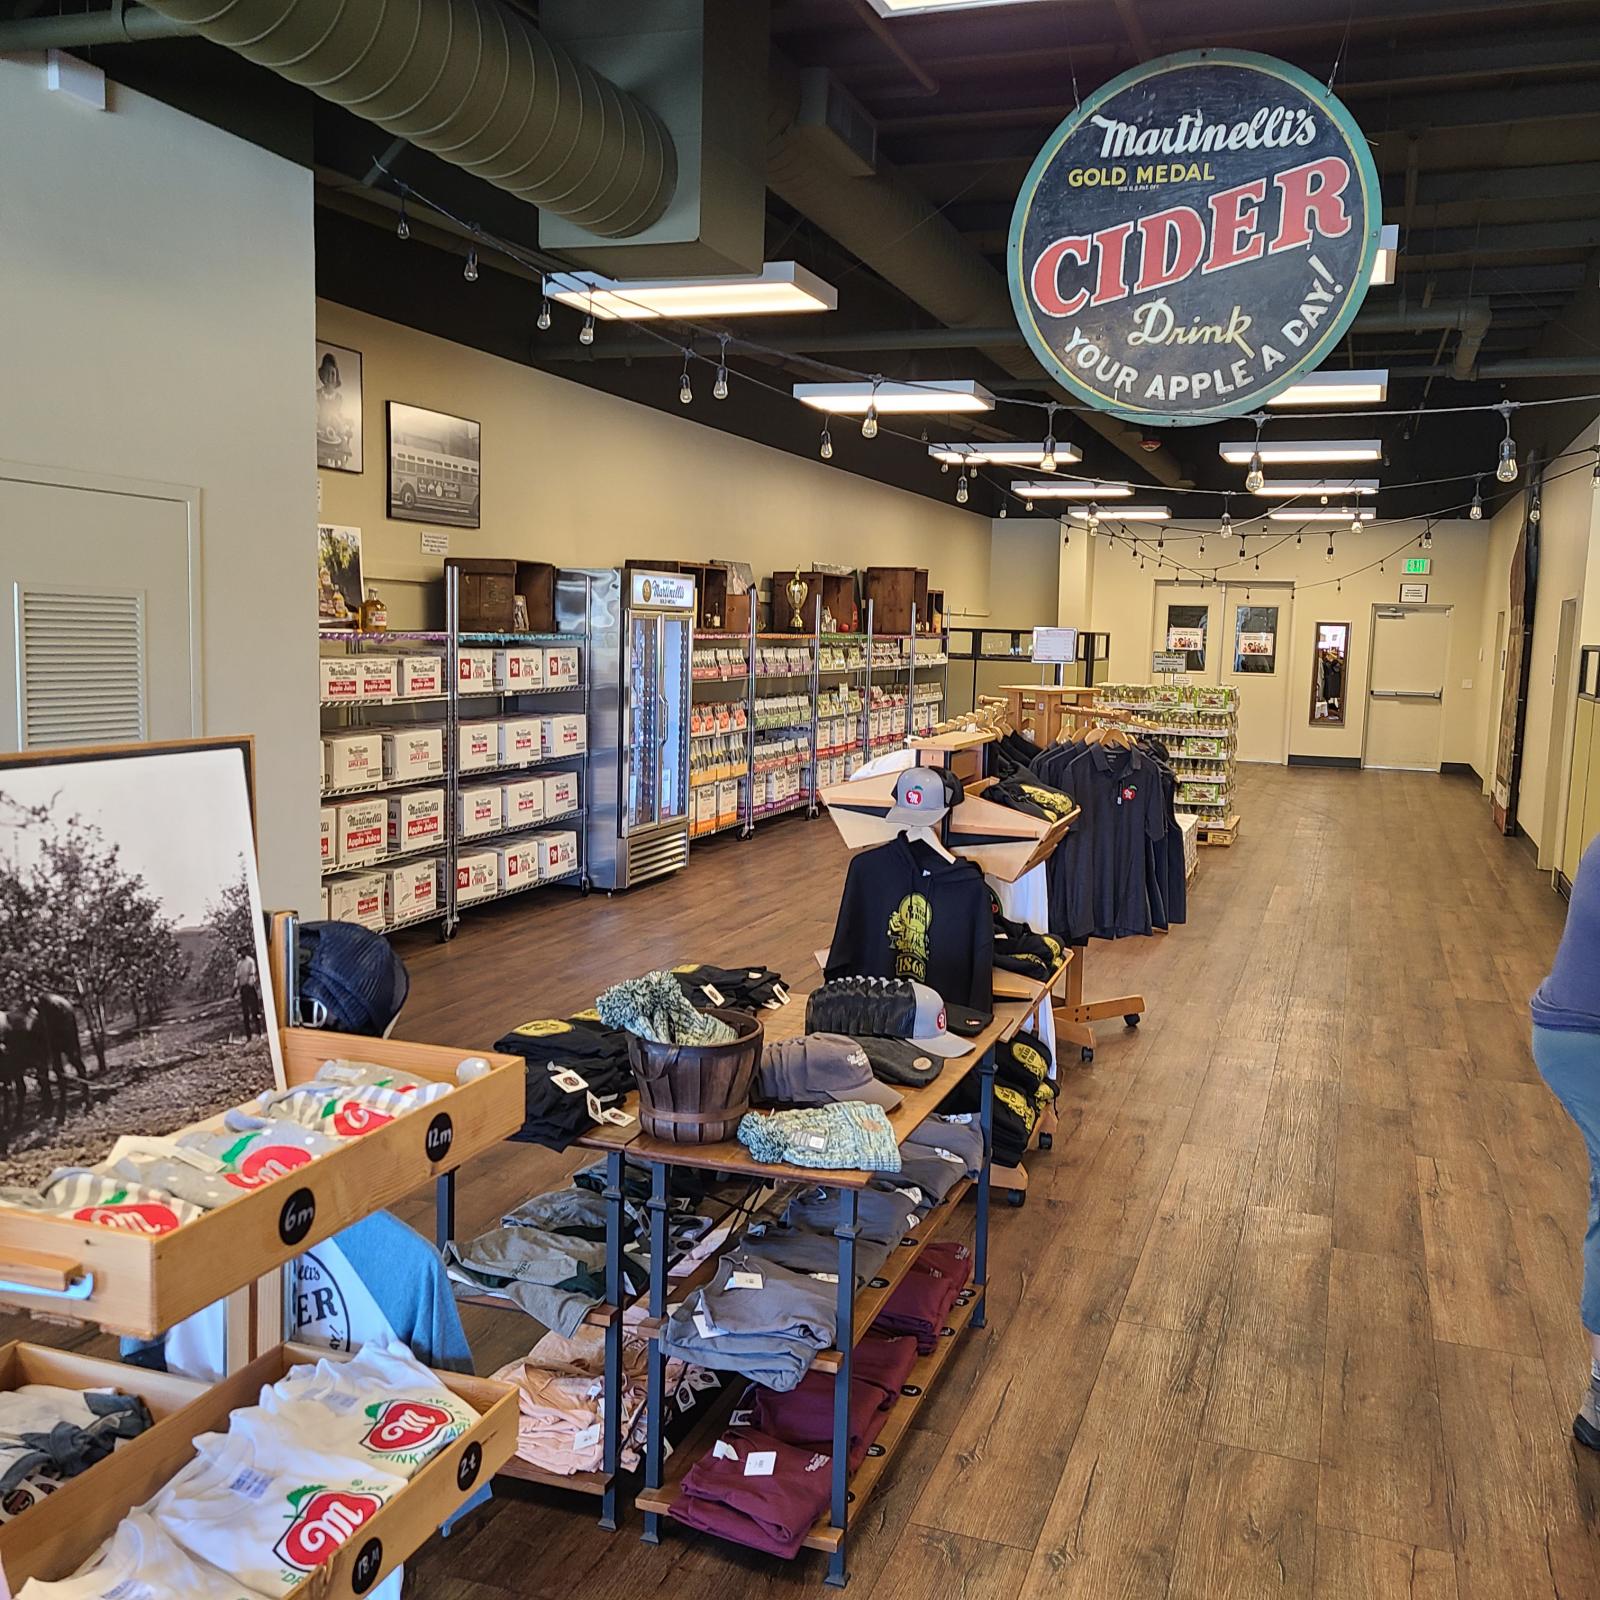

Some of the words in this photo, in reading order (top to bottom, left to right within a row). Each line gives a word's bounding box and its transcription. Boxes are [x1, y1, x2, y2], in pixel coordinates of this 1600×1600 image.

[1091, 106, 1317, 159] Martinelli's
[1068, 168, 1127, 188] GOLD
[1136, 162, 1215, 184] MEDAL
[1031, 155, 1352, 318] CIDER
[1064, 326, 1138, 393] YOUR
[1144, 357, 1255, 401] APPLE
[1260, 344, 1286, 373] A
[1281, 255, 1344, 347] DAY!
[1127, 296, 1254, 359] Drink
[1407, 558, 1425, 572] EXIT
[348, 836, 364, 847] Apple
[365, 834, 380, 843] Juice
[408, 824, 423, 835] Apple
[423, 822, 437, 831] Juice
[899, 956, 924, 978] 1868
[428, 1128, 451, 1148] 12m
[284, 1202, 314, 1232] 6m
